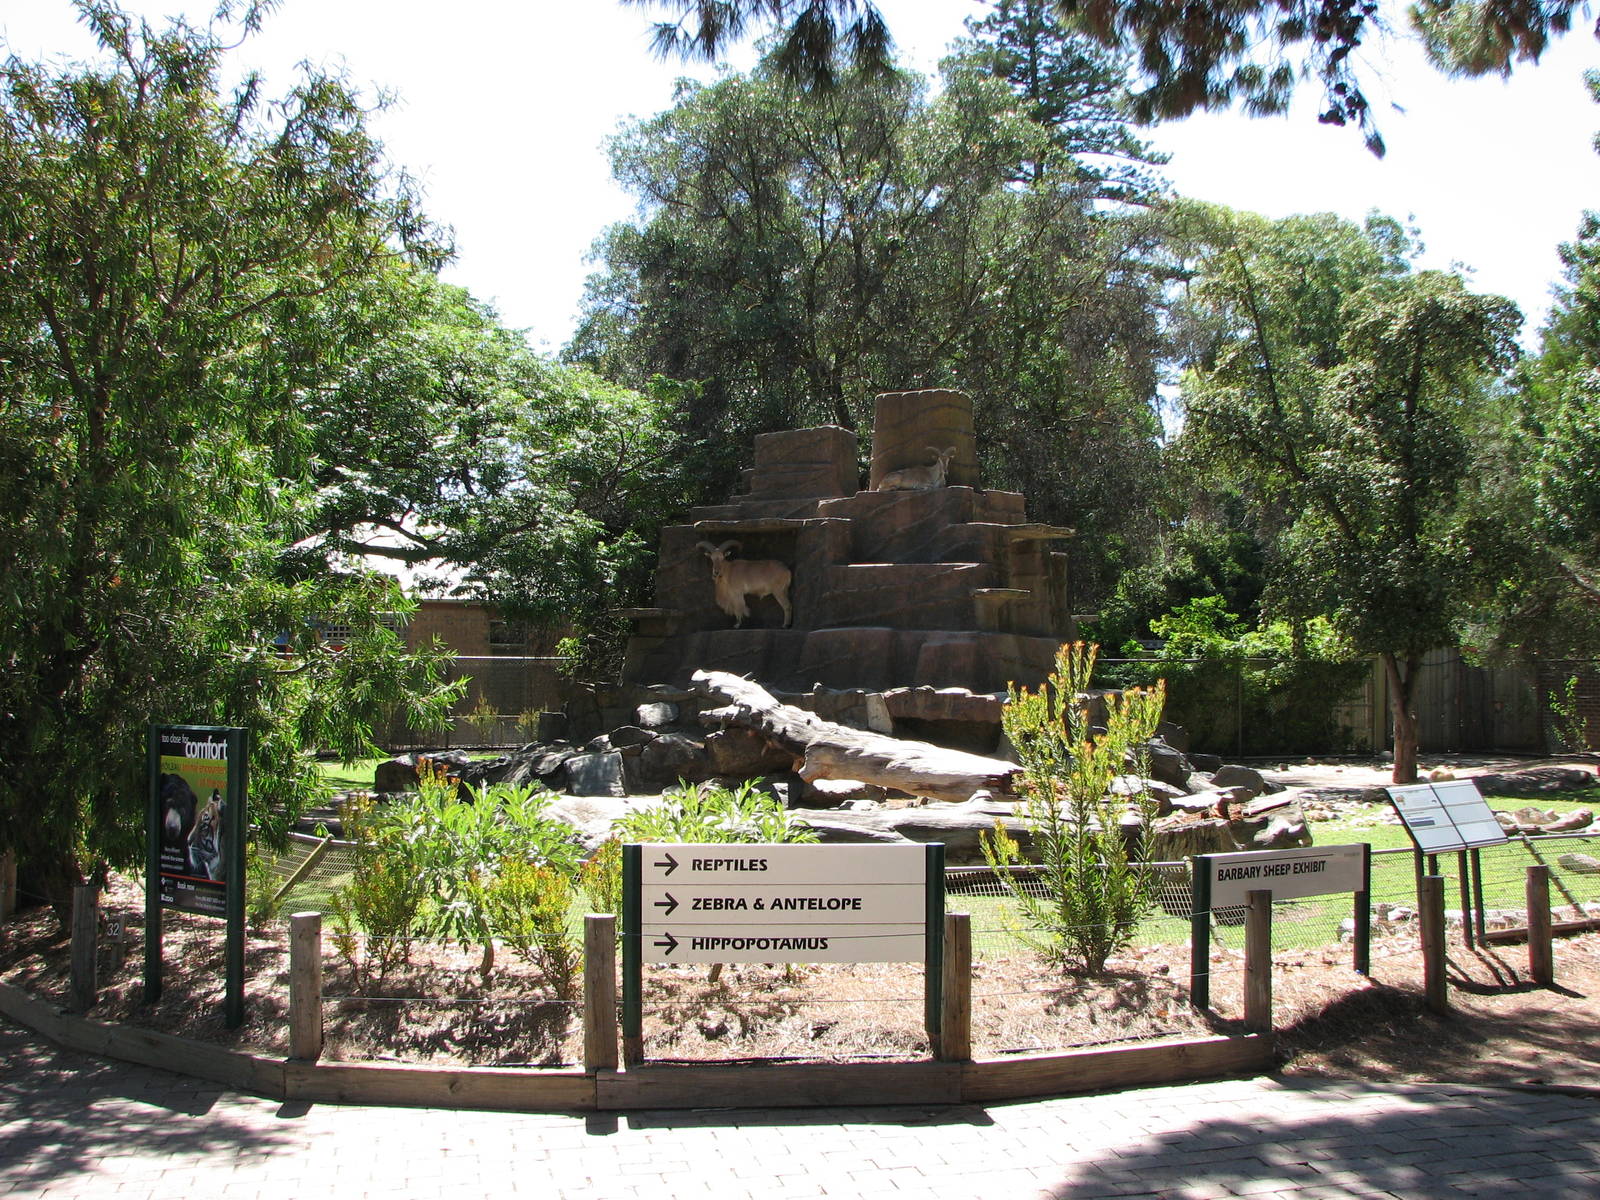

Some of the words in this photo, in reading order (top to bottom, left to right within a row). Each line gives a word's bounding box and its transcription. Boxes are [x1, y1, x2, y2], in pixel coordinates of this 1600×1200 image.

[170, 733, 182, 744] close
[185, 735, 228, 760] comfort
[691, 858, 768, 871] REPTILES
[1218, 865, 1261, 881] BARBARY
[1263, 863, 1290, 877] SHEEP
[1293, 860, 1326, 874] EXHIBIT
[691, 898, 748, 910] ZEBRA
[753, 898, 765, 910] &
[770, 898, 862, 910] ANTELOPE
[107, 922, 120, 936] 32
[691, 937, 828, 950] HIPPOPOTAMUS
